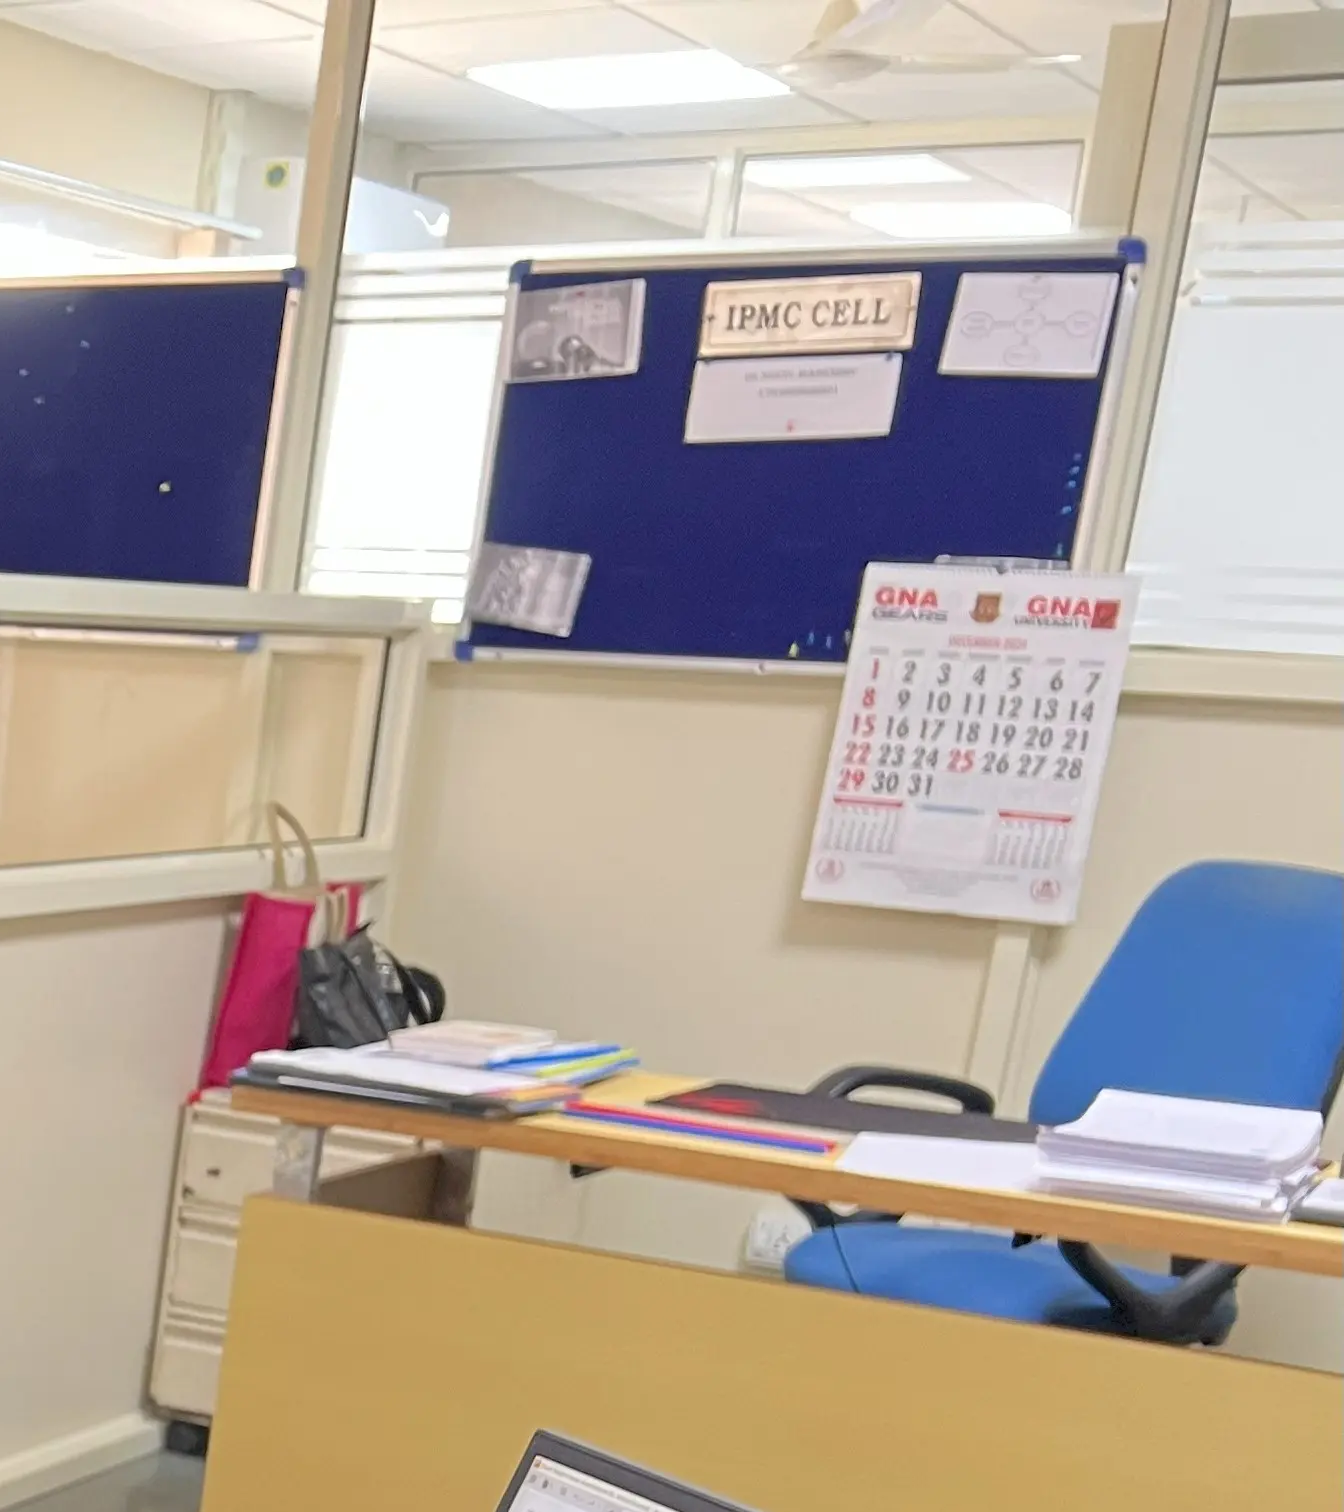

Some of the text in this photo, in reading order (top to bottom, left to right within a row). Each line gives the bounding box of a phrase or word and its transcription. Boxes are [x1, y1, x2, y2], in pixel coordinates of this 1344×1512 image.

[725, 298, 894, 332] IPMC CELL
[875, 586, 939, 608] GNA
[1027, 594, 1091, 617] GNA
[872, 659, 1101, 694] 1 2 3 4 5 6 7
[862, 688, 1095, 722] 8 9 10 11 12 13 14
[852, 714, 1089, 751] 15 16 17 18 19 20 21
[845, 741, 1083, 780] 22 23 24 25 26 27 28
[838, 769, 934, 796] 29 30 31
